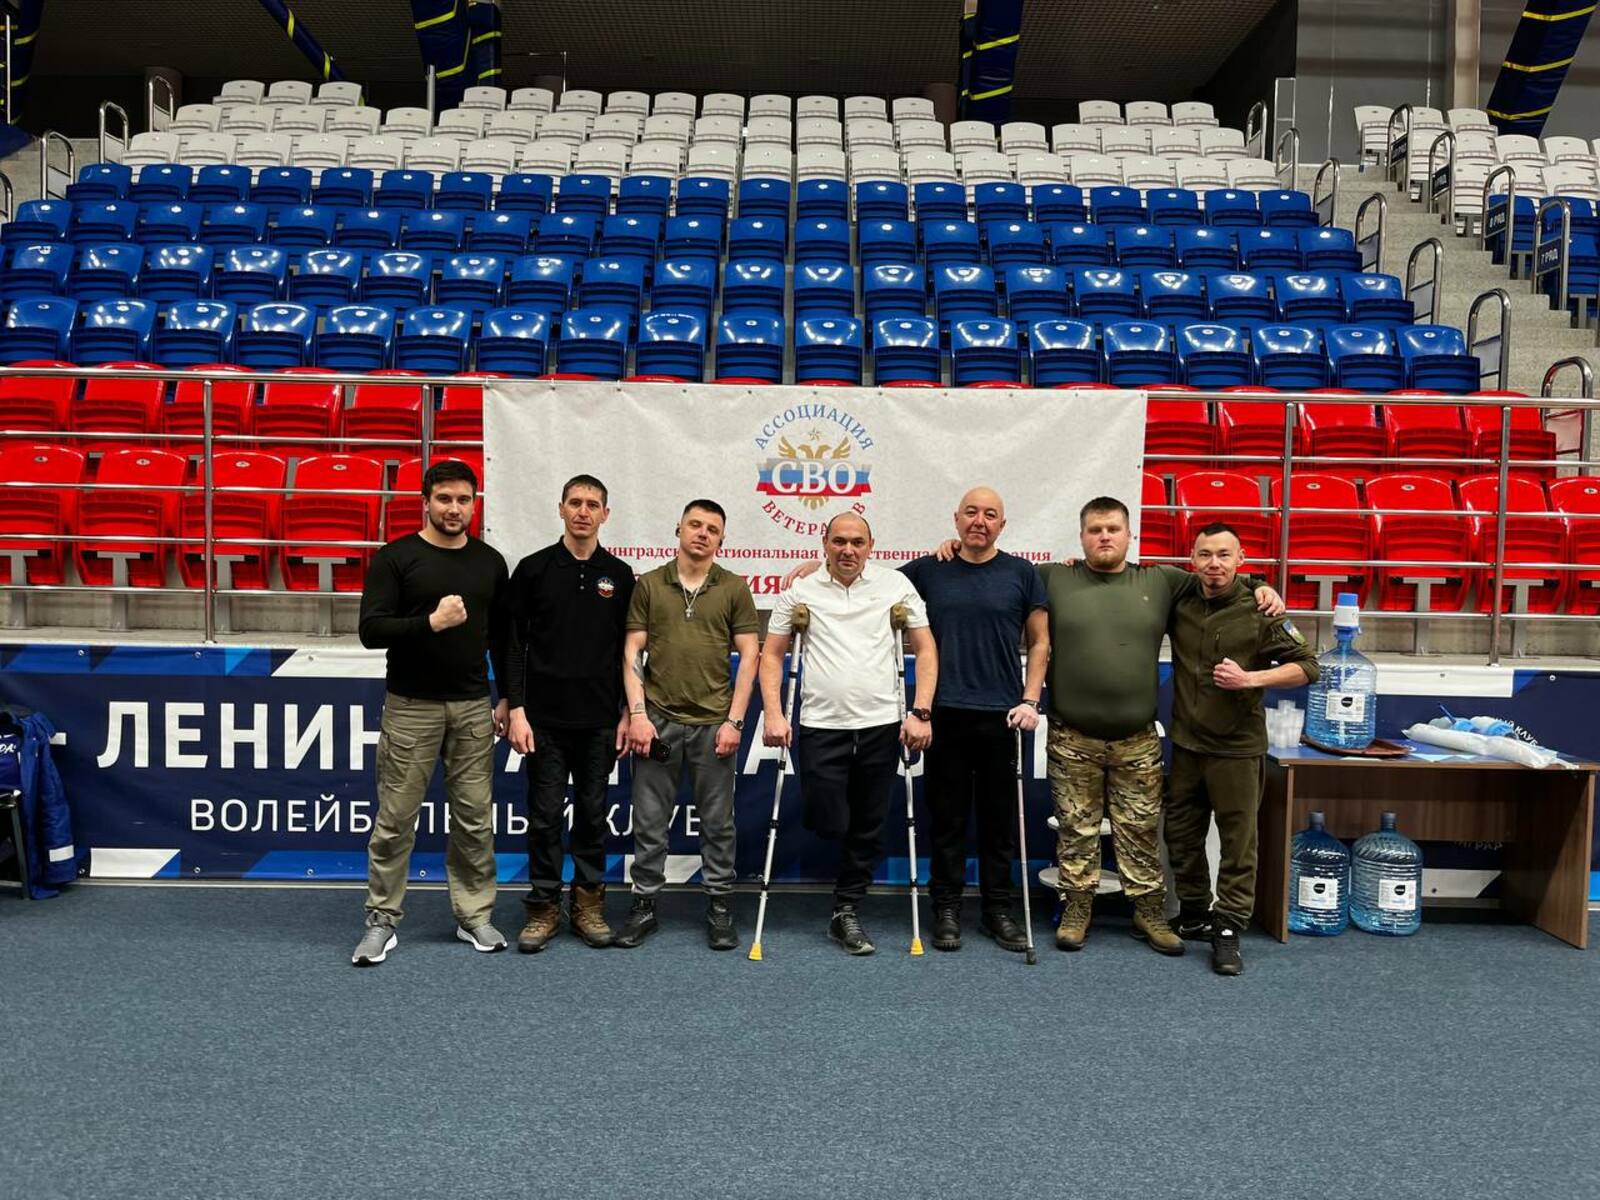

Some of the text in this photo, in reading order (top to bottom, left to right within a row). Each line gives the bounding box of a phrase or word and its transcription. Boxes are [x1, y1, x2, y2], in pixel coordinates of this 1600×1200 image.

[754, 403, 875, 451] АССОЦИАЦИЯ
[771, 460, 857, 495] СВО
[762, 500, 867, 537] ВЕТЕРАВ
[717, 548, 819, 560] егиональная
